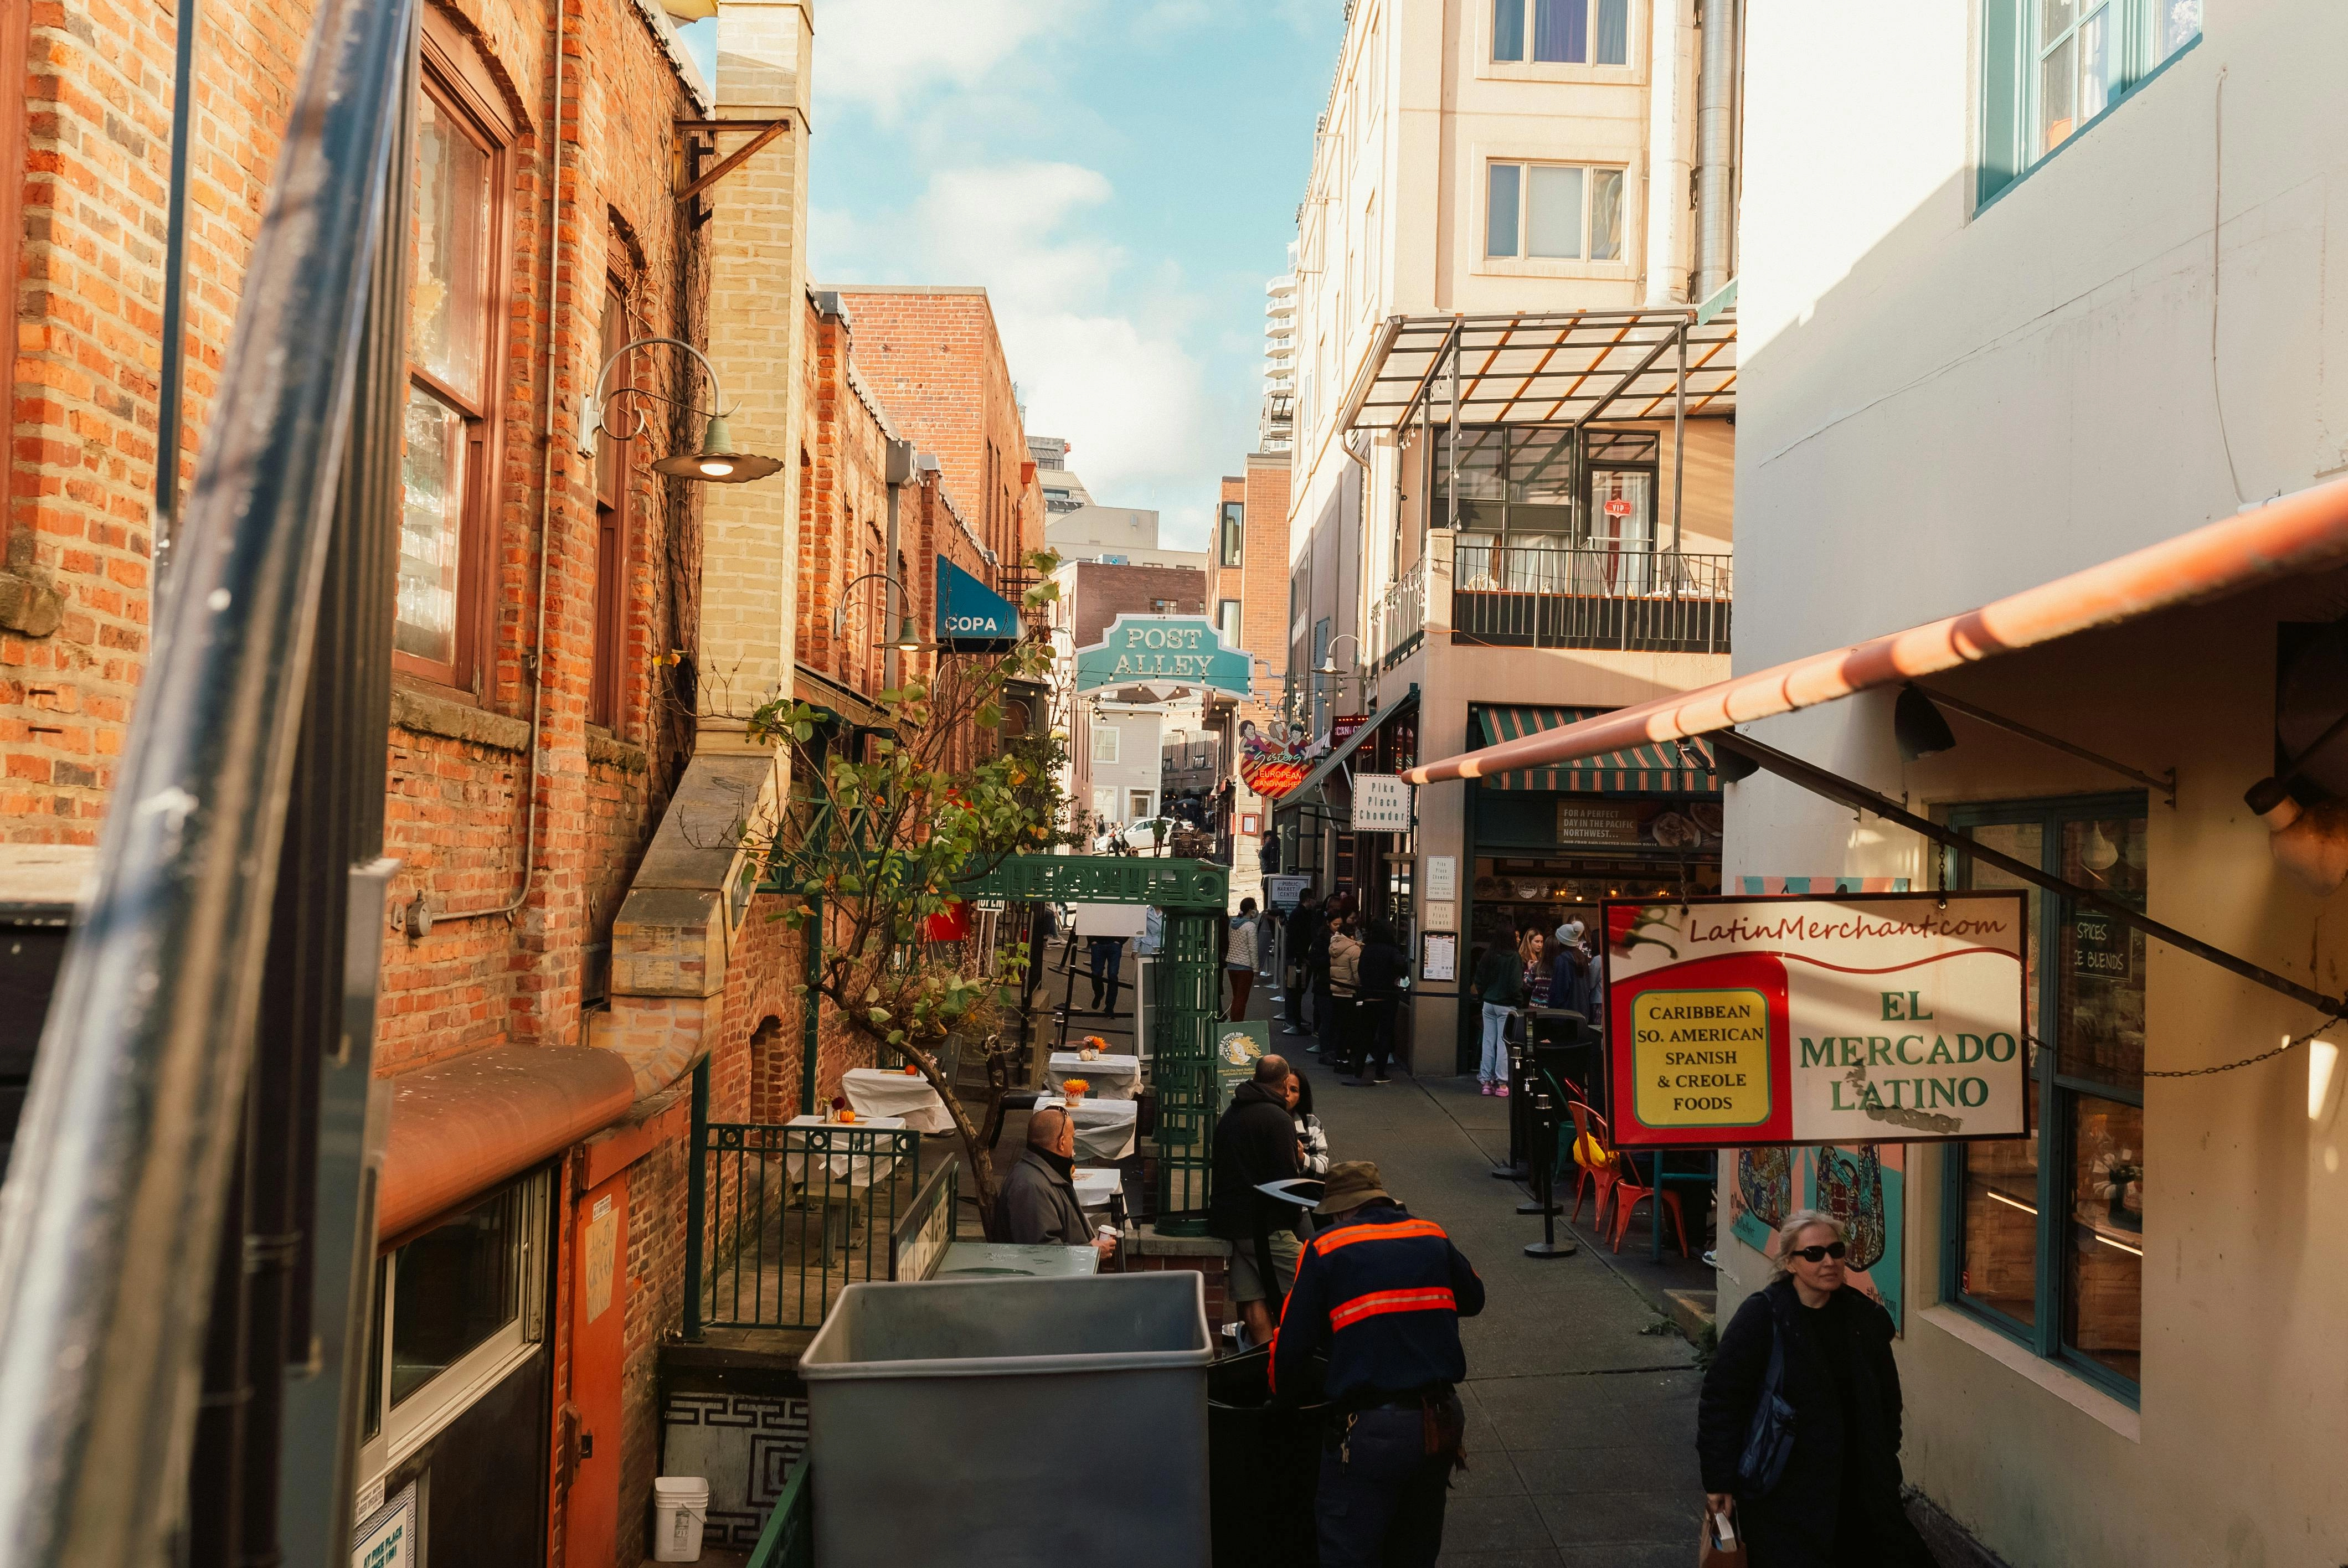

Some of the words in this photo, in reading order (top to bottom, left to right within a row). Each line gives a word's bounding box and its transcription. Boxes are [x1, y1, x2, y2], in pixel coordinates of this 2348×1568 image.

[945, 616, 997, 631] COPA
[1126, 628, 1202, 649] POST
[1115, 654, 1214, 676] ALLEY
[1260, 770, 1302, 780] EUROPEAN
[1372, 782, 1394, 792] Pike
[1368, 796, 1397, 806] Place
[1360, 809, 1404, 821] Chowder
[1590, 819, 1604, 828] THE
[1606, 820, 1634, 828] PACIFIC
[1563, 829, 1618, 838] NORTHWEST...
[1690, 914, 2007, 943] LatinMerchant.com
[2077, 922, 2107, 940] SPICES
[2088, 951, 2124, 970] BLENDS
[1649, 1005, 1750, 1020] CARIBBEAN
[1879, 991, 1933, 1021] EL
[1638, 1030, 1664, 1043] SO.
[1669, 1028, 1764, 1042] AMERICAN
[1799, 1032, 2016, 1068] MERCADO
[1665, 1051, 1737, 1065] SPANISH
[1657, 1075, 1671, 1088] &
[1675, 1074, 1746, 1088] CREOLE
[1830, 1076, 1989, 1111] LATINO
[1674, 1097, 1733, 1111] FOODS
[372, 1541, 384, 1564] PIKE
[385, 1524, 403, 1549] PLACE
